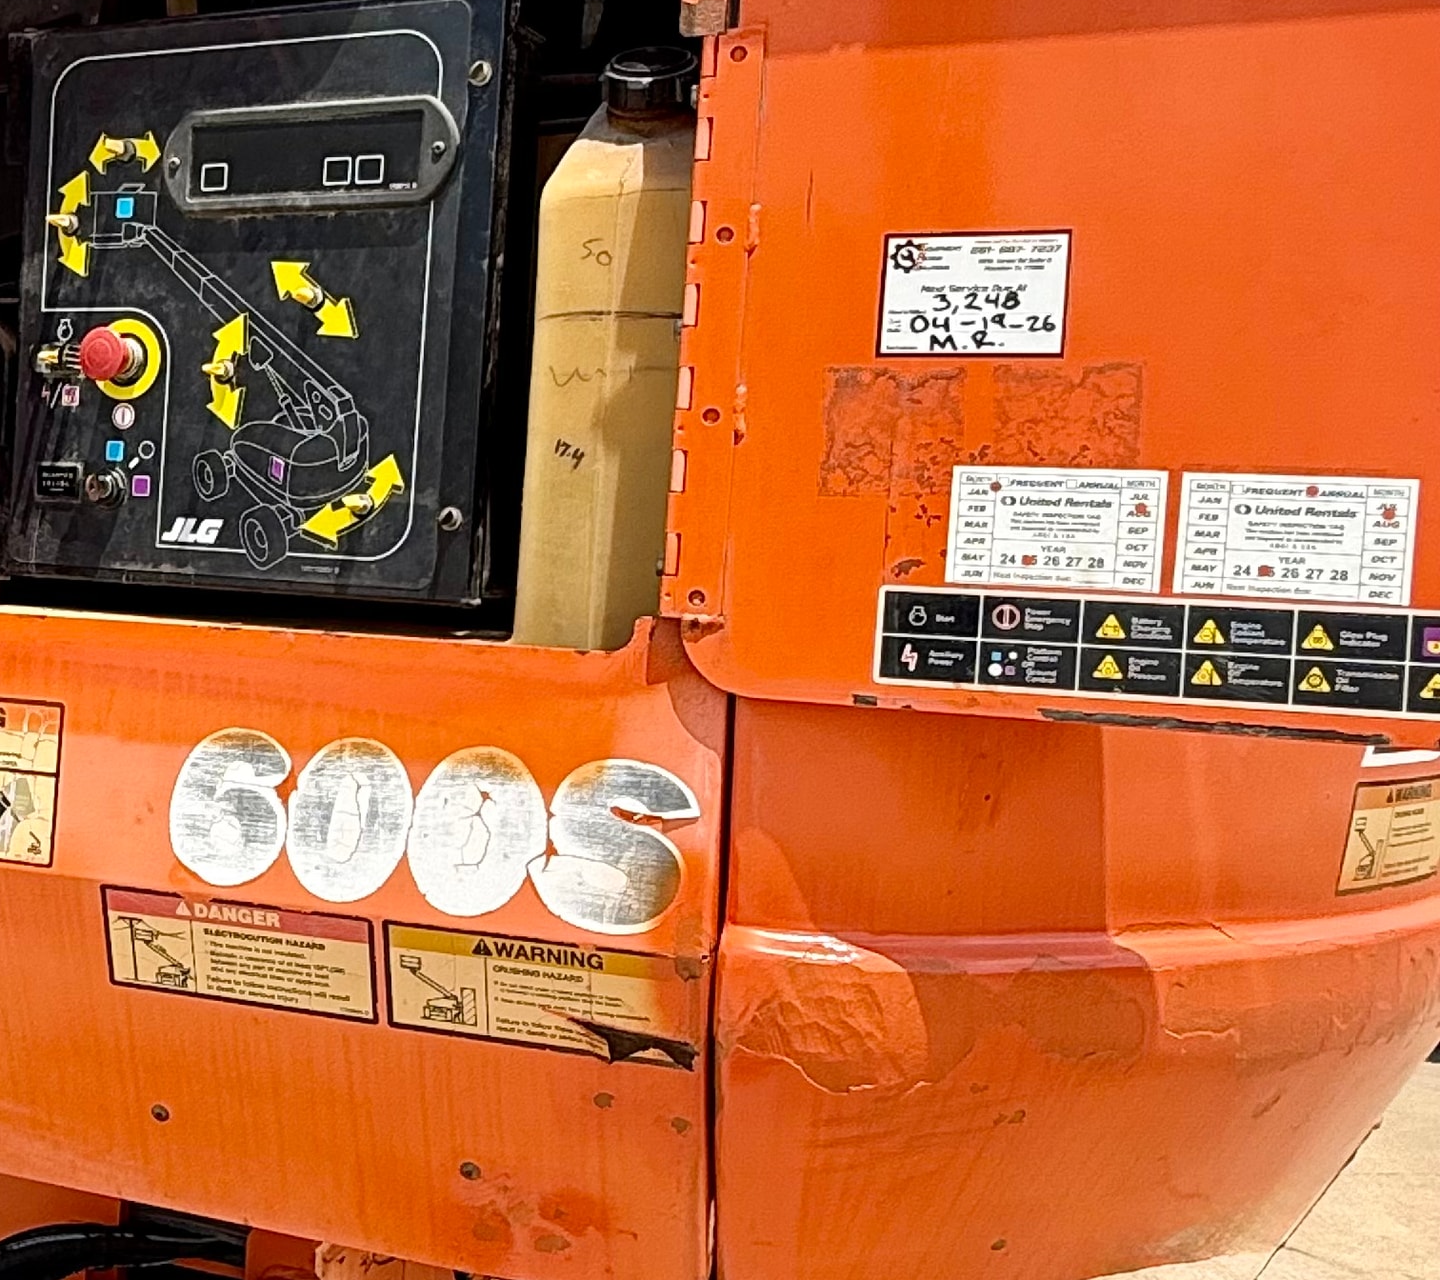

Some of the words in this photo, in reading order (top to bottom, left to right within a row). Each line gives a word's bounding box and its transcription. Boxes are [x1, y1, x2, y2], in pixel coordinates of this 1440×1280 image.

[949, 284, 989, 292] Service
[991, 284, 1013, 292] Due
[932, 290, 1021, 315] 3,248
[1244, 487, 1304, 496] FREQUENT
[1019, 495, 1062, 507] United
[1064, 498, 1112, 508] Rentals
[1198, 496, 1222, 504] JAN
[1255, 505, 1302, 516] United
[1305, 507, 1357, 518] Rentals
[1198, 513, 1219, 521] FEB
[161, 517, 224, 544] JLG
[1194, 530, 1220, 539] MAR
[1373, 538, 1397, 546] SEP
[1041, 545, 1066, 553] YEAR
[1125, 543, 1148, 552] OCT
[1193, 547, 1217, 556] APR
[961, 553, 985, 561] MAY
[1000, 554, 1016, 565] 24
[1043, 556, 1060, 567] 26
[1065, 557, 1082, 568] 27
[1088, 557, 1104, 569] 28
[1278, 556, 1306, 565] YEAR
[1371, 556, 1397, 564] OCT
[1123, 560, 1147, 568] NOV
[1191, 563, 1217, 572] MAY
[961, 570, 983, 578] JUN
[1233, 565, 1251, 576] 24
[1281, 567, 1299, 579] 26
[1305, 568, 1323, 580] 27
[1329, 570, 1348, 581] 28
[1368, 573, 1396, 581] NOV
[1122, 577, 1146, 585] DEC
[1191, 582, 1214, 590] JUN
[1248, 585, 1292, 594] Inspection
[1368, 591, 1393, 599] DEC
[169, 727, 700, 935] 600S
[194, 903, 281, 928] DANGER
[203, 928, 283, 945] ELECTROCUTION
[285, 939, 325, 950] HAZARD
[493, 941, 604, 970] WARNING
[493, 964, 540, 978] CRUSHING
[543, 971, 584, 983] HAZARD
[206, 974, 232, 984] Failure
[248, 991, 275, 999] serious
